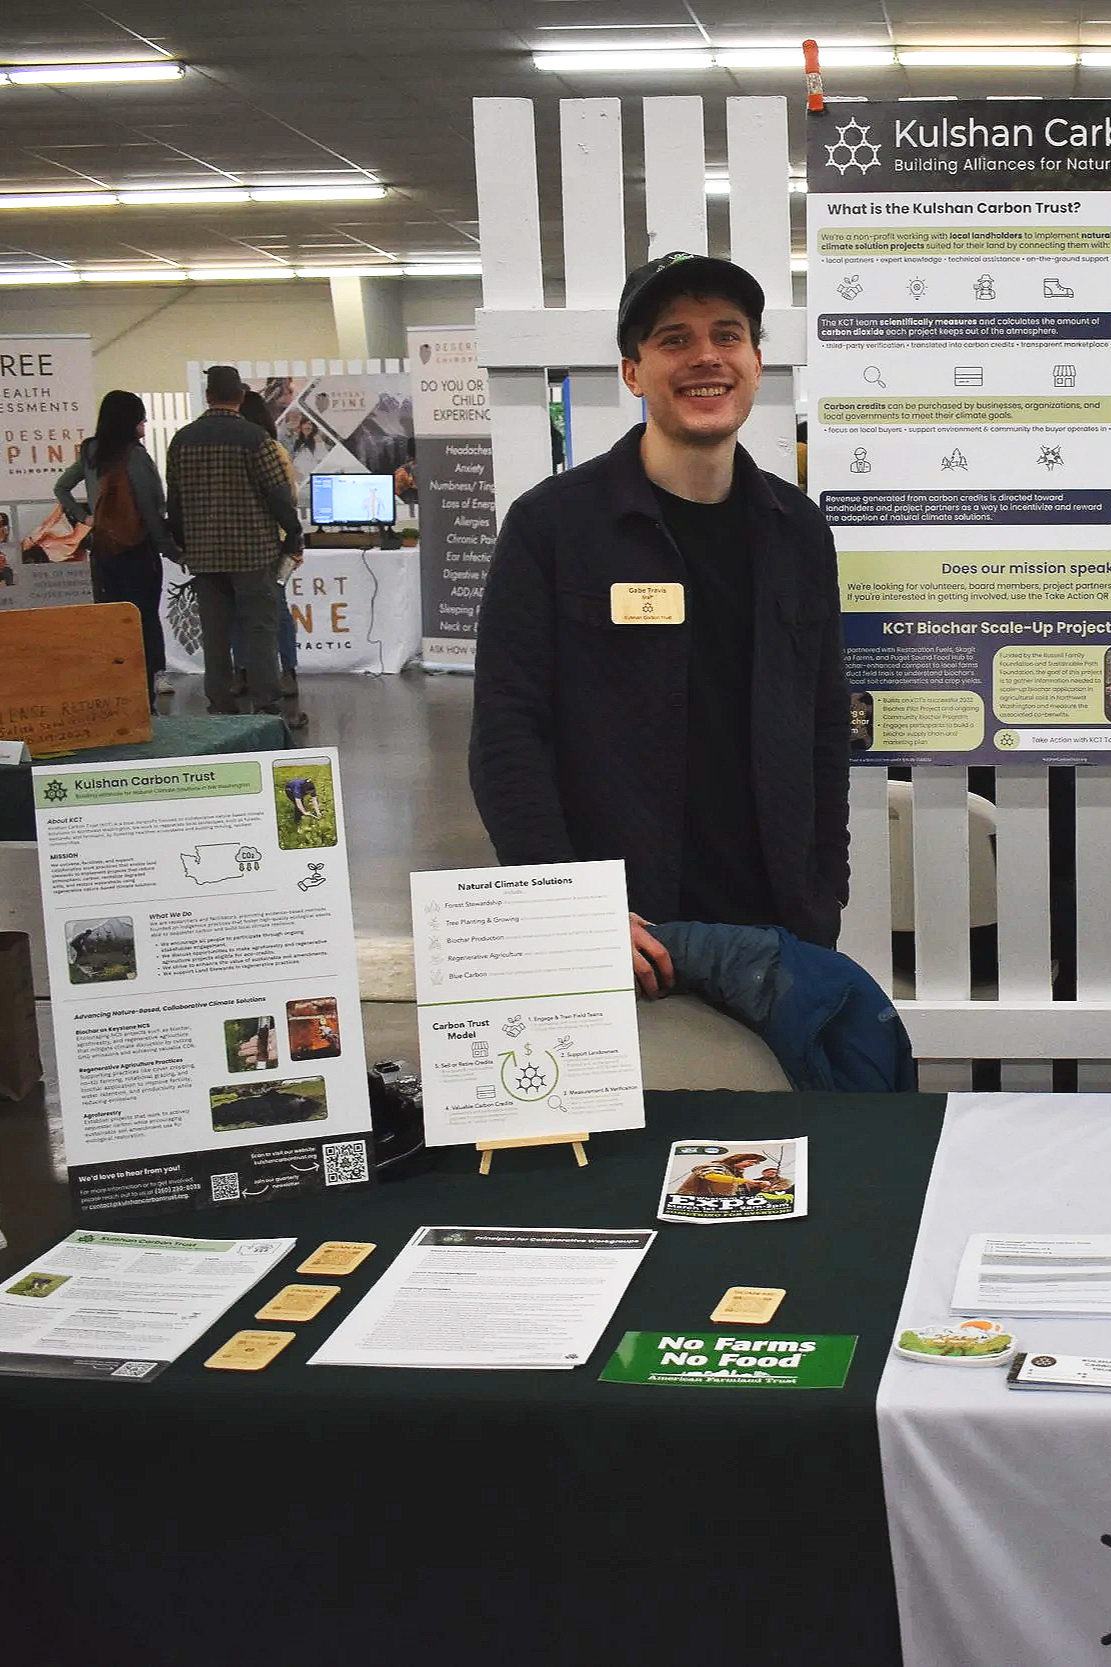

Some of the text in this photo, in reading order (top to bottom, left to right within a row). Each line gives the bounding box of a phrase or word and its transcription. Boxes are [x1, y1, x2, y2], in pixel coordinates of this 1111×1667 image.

[895, 117, 1032, 148] Kulshan
[894, 158, 957, 174] Building
[963, 157, 1034, 170] Alliances
[1040, 157, 1061, 170] for
[827, 201, 1080, 214] What is the Kulshan Carbon Trust?
[853, 233, 894, 242] non-profit
[896, 232, 929, 242] working
[949, 232, 970, 241] local
[971, 232, 1022, 241] landholders
[1034, 232, 1079, 242] implement
[1081, 231, 1111, 241] natural
[855, 240, 888, 250] solution
[890, 240, 924, 251] projects
[926, 240, 951, 249] suited
[1006, 242, 1017, 250] by
[1018, 241, 1065, 250] connecting
[0, 354, 53, 376] REE
[421, 379, 484, 392] DO YOU OR
[3, 388, 51, 398] EALTH
[452, 395, 485, 406] CHILD
[0, 402, 79, 413] ESSMENTS
[434, 409, 491, 421] EXPERIENC
[5, 429, 85, 442] DESERT
[455, 464, 485, 475] Anxiety
[442, 499, 496, 511] Loss of Energ
[454, 516, 490, 529] Allergies
[446, 534, 478, 544] Chronic
[446, 552, 460, 561] Ear
[942, 563, 977, 574] Does
[981, 565, 1005, 573] our
[1009, 562, 1065, 573] mission
[443, 569, 479, 581] Digestive
[293, 577, 347, 596] ERT
[439, 604, 474, 617] Sleeping
[290, 603, 349, 633] NE
[440, 622, 460, 631] Neck
[883, 620, 1111, 637] KCT Biochar Scale-Up Project
[296, 641, 352, 650] RACTIC
[74, 771, 214, 789] Kulshan Carbon Trust
[458, 876, 572, 890] Natural Climate Solutions
[432, 1019, 489, 1030] Carbon Trust
[447, 1031, 475, 1039] Model
[78, 1174, 98, 1182] We'd
[99, 1172, 115, 1180] love
[125, 1168, 143, 1177] hear
[144, 1166, 162, 1174] from
[163, 1164, 180, 1174] you!
[668, 1195, 768, 1210] Expo
[657, 1336, 816, 1352] No Farms
[660, 1352, 803, 1368] No Food
[648, 1373, 797, 1383] American Farmland Trust
